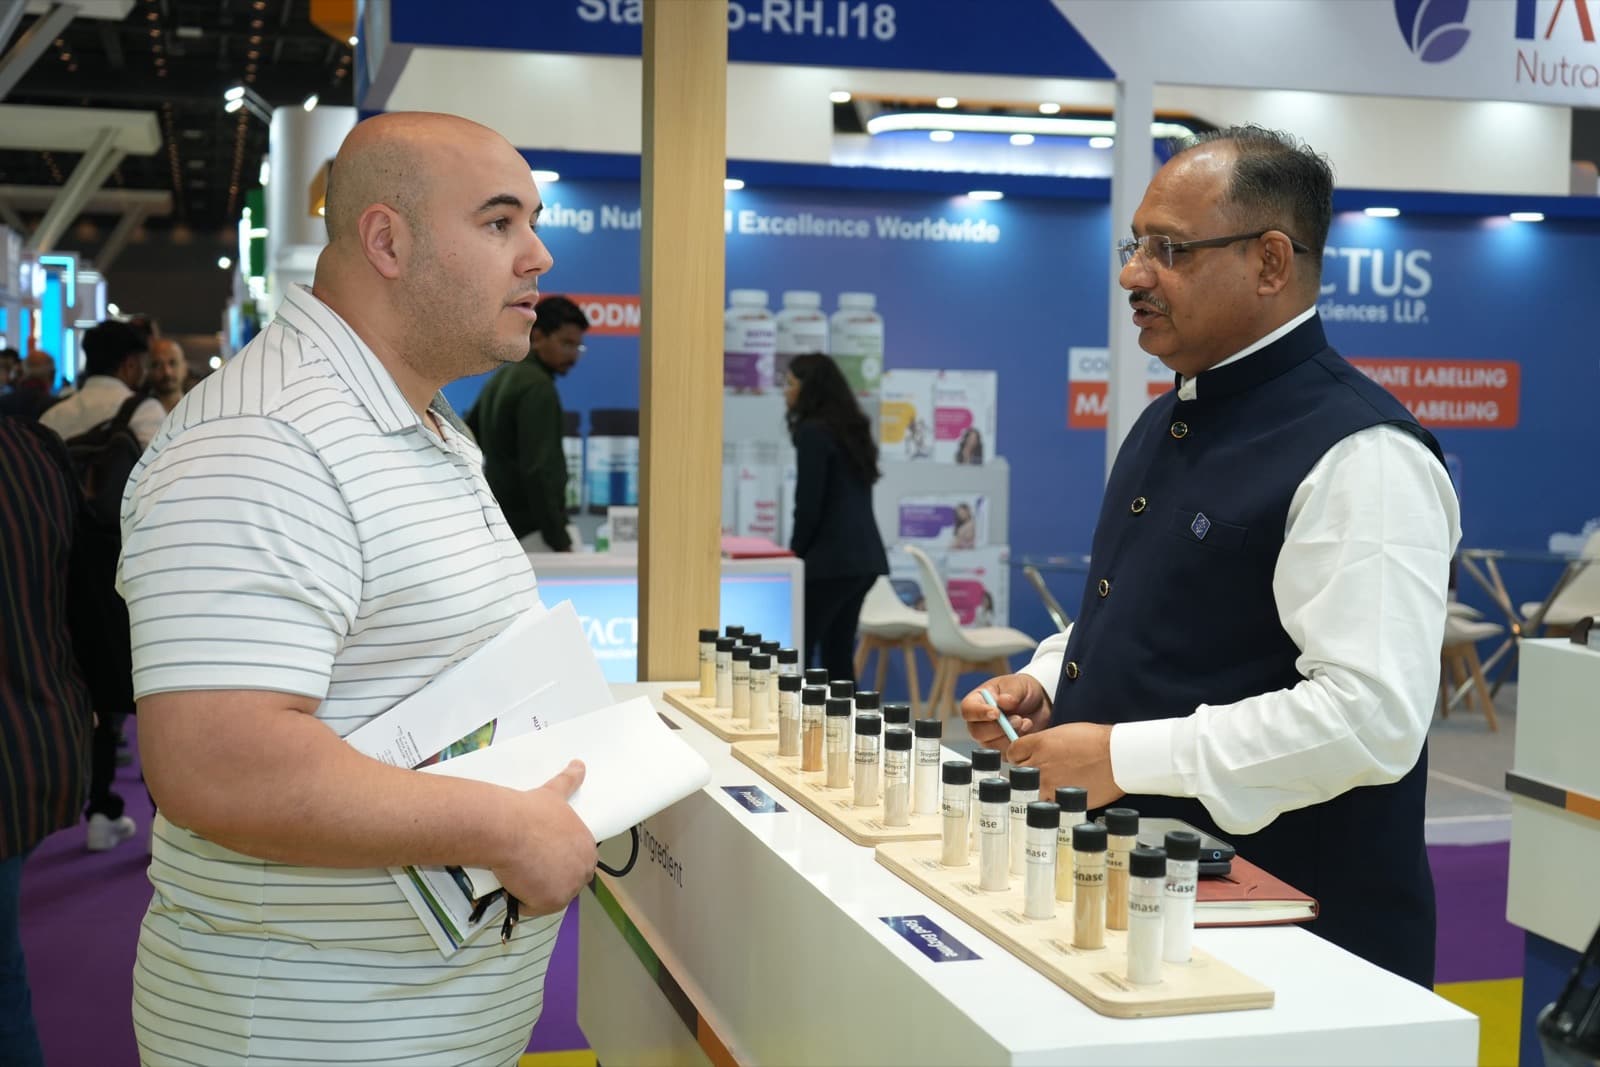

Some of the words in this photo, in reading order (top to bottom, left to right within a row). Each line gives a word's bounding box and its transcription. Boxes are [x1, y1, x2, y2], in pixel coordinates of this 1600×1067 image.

[576, 0, 643, 25] Sta
[537, 204, 595, 233] king
[738, 209, 871, 239] Excellence
[876, 214, 1001, 244] Worldwide
[1318, 298, 1388, 323] ciences
[1414, 366, 1508, 390] LABELLING
